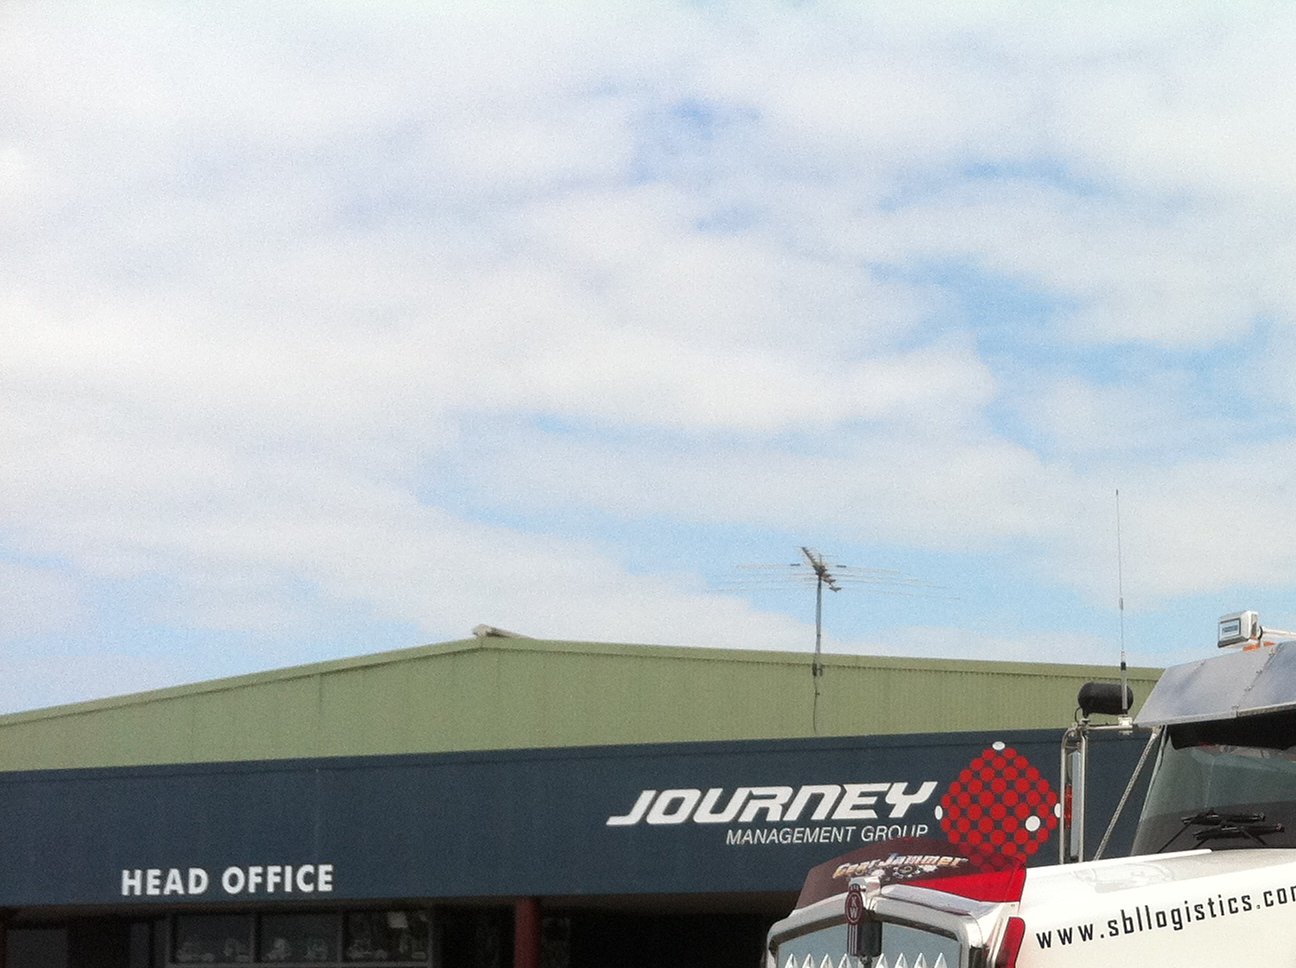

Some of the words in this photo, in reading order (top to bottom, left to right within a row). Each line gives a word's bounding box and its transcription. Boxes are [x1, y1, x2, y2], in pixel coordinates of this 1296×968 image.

[606, 781, 938, 826] JOURNEY
[726, 826, 855, 845] MANAGEMENT
[861, 824, 928, 843] GROUP
[121, 867, 209, 896] HEAD
[222, 864, 333, 894] OFFICE
